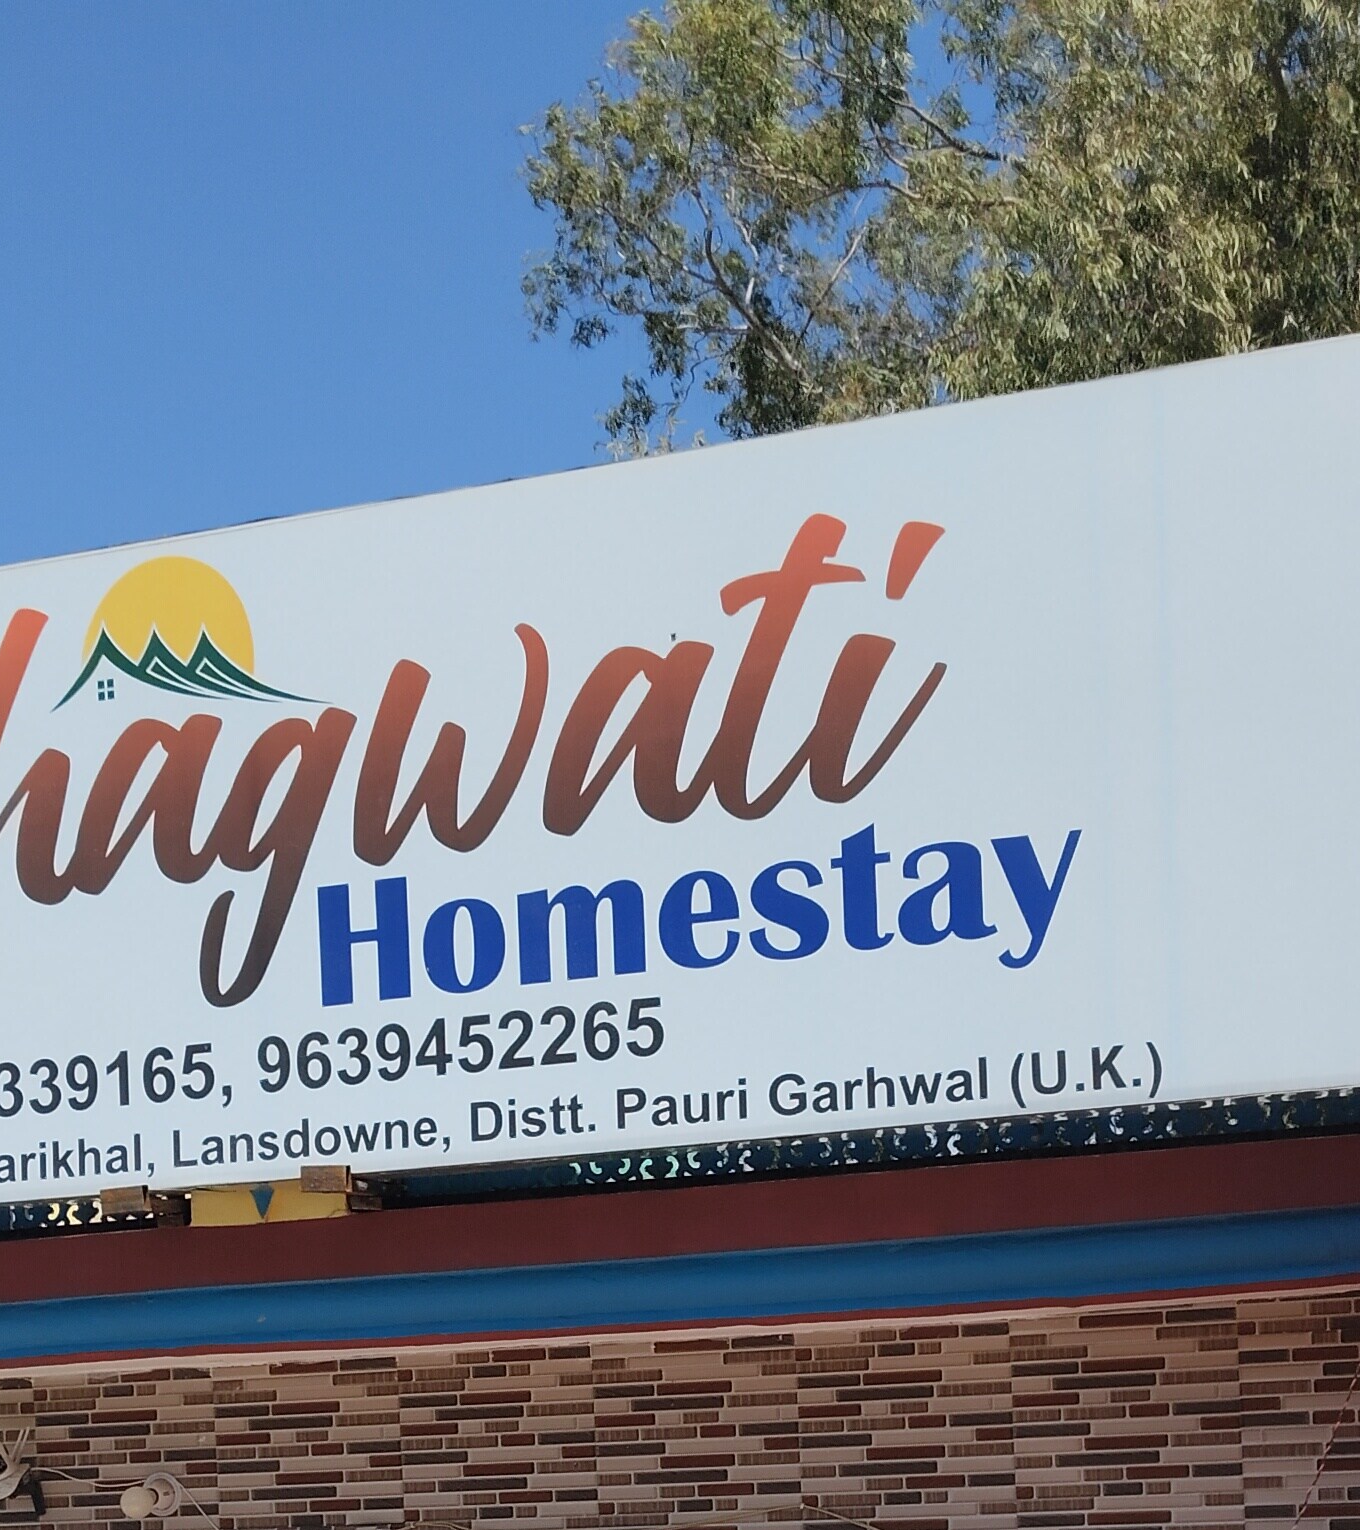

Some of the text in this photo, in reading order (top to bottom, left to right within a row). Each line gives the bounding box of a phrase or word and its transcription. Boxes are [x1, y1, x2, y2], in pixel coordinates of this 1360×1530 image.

[317, 822, 1083, 1008] Homestay
[172, 1118, 452, 1168] Lansdowne,
[470, 1094, 597, 1142] Distt.
[616, 1077, 748, 1130] Pauri
[768, 1056, 988, 1116] Garhwal
[1010, 1041, 1163, 1109] (U.K.)
[257, 996, 666, 1093] 9639452265
